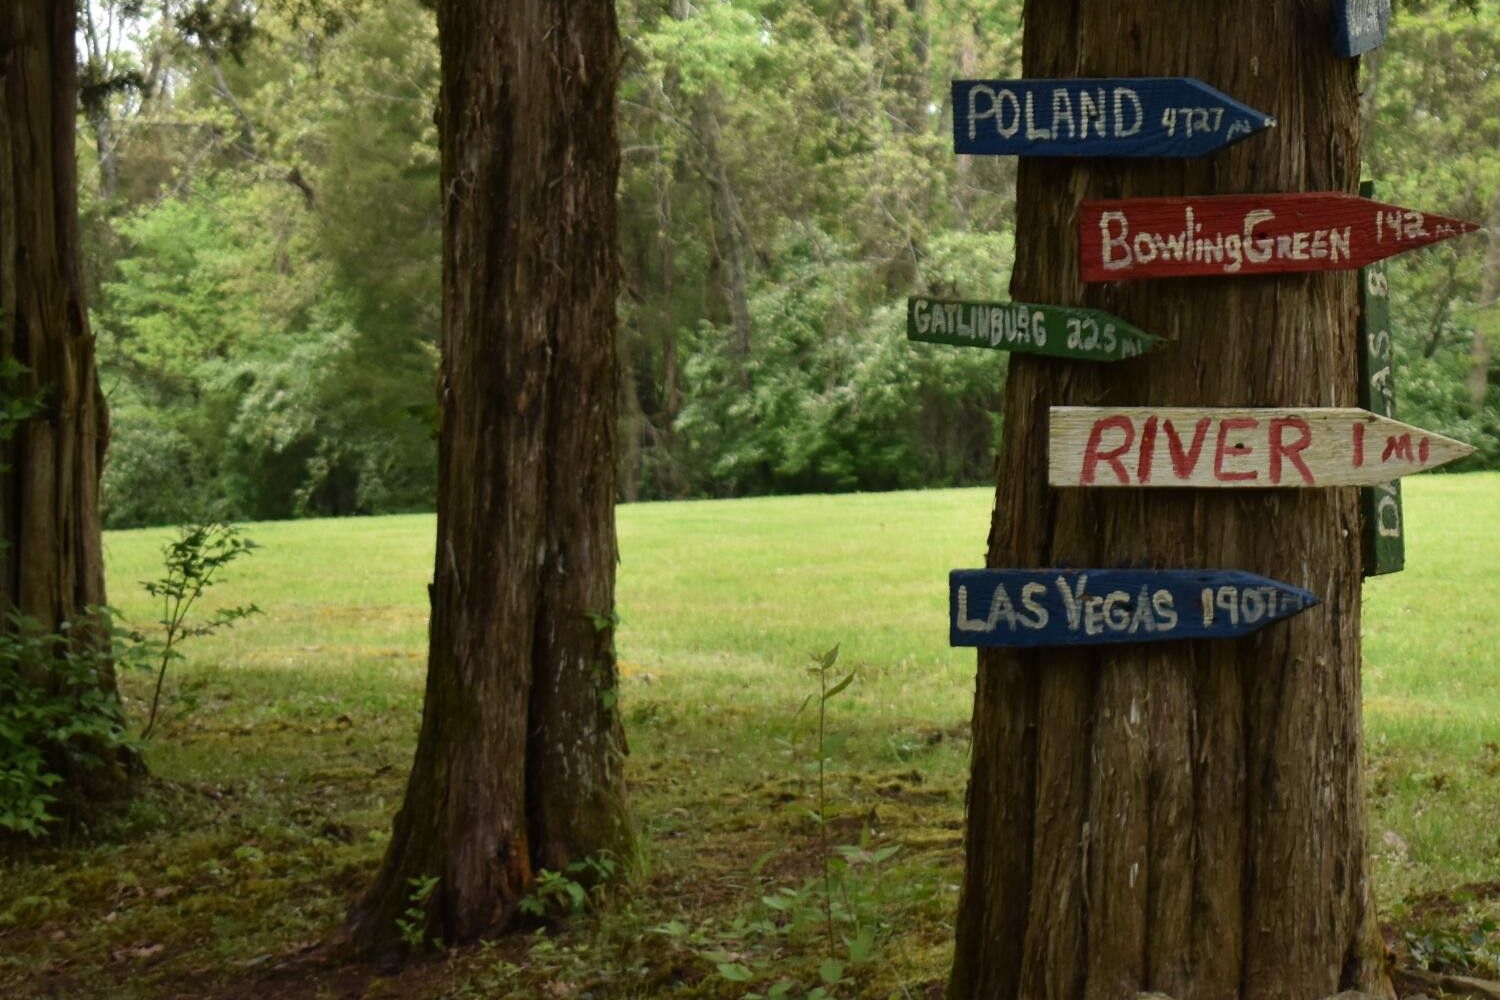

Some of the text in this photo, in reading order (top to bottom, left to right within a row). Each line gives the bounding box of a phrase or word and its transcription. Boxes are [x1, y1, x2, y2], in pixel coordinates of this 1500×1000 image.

[968, 84, 1143, 140] POLAND
[1161, 107, 1225, 138] 4727
[914, 300, 1046, 347] GATLINBURG
[1080, 415, 1315, 486] RIVER
[957, 582, 1049, 633] LAS
[1056, 575, 1178, 636] VEGAS
[1202, 586, 1279, 627] 1907
